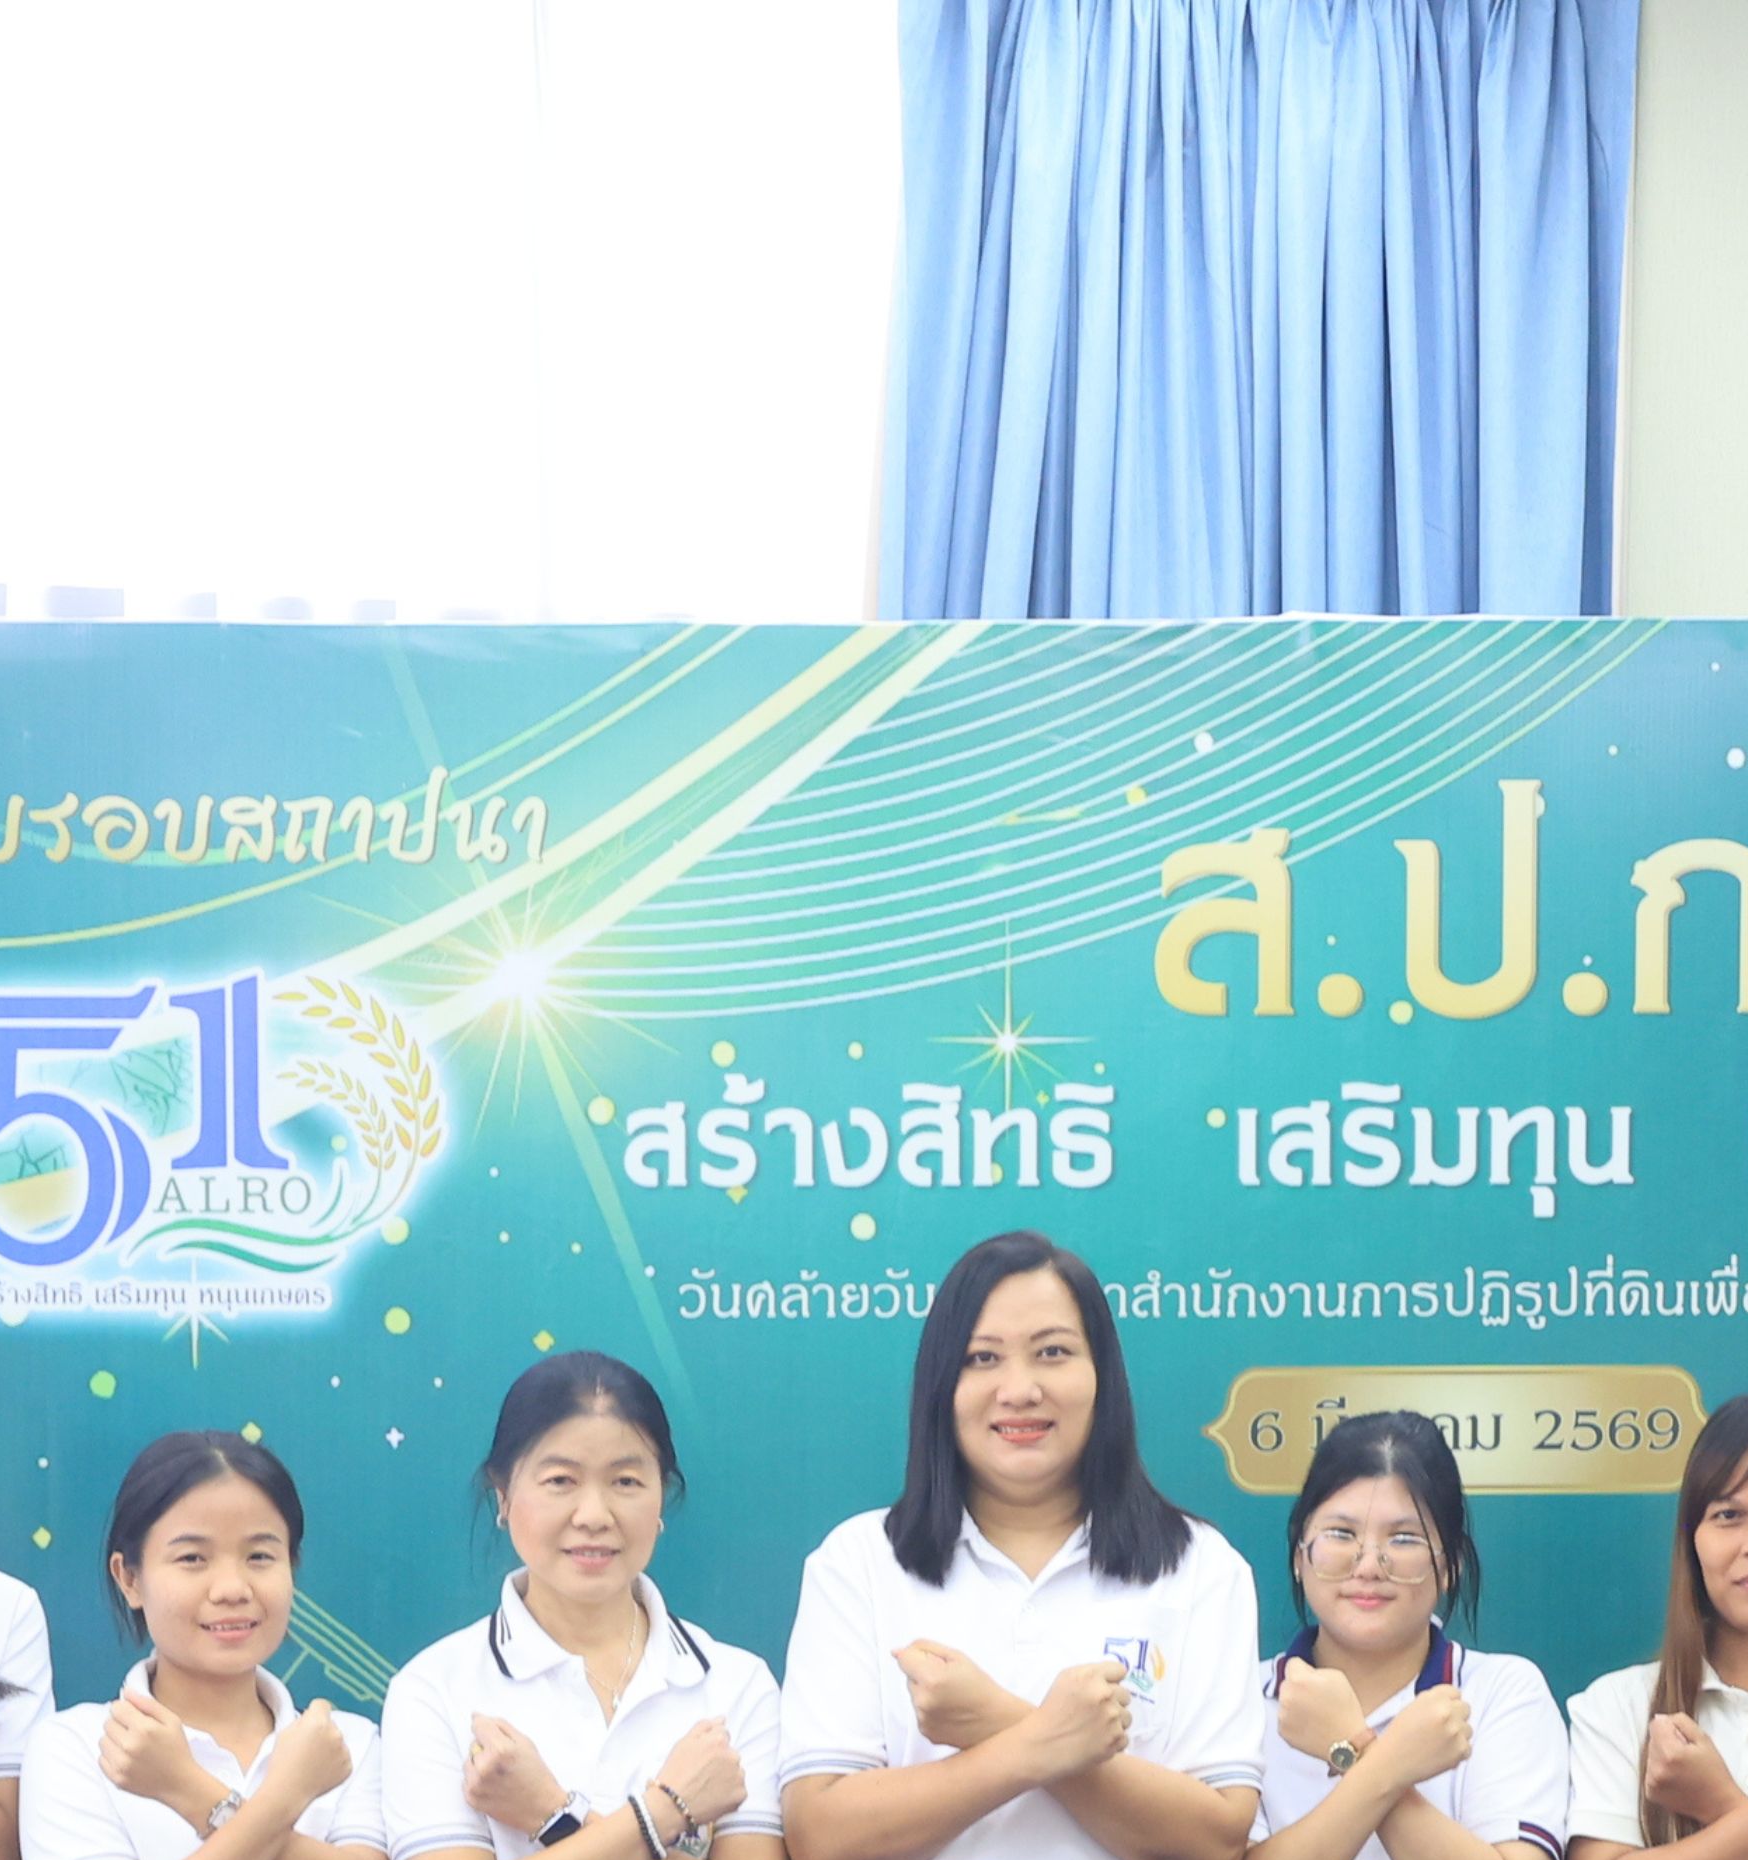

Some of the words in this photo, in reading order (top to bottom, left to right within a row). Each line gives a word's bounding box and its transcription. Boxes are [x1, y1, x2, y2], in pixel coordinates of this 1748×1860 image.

[623, 1073, 1115, 1189] สร้างสิทธิ
[1238, 1081, 1634, 1218] เสริมทุน
[152, 1176, 312, 1215] ALRO
[95, 1279, 186, 1311] เสริมทุน
[199, 1285, 326, 1311] หนุนเกษตร
[1250, 1411, 1284, 1451] 6
[1310, 1396, 1503, 1451] มีคม
[1533, 1408, 1682, 1451] 2569
